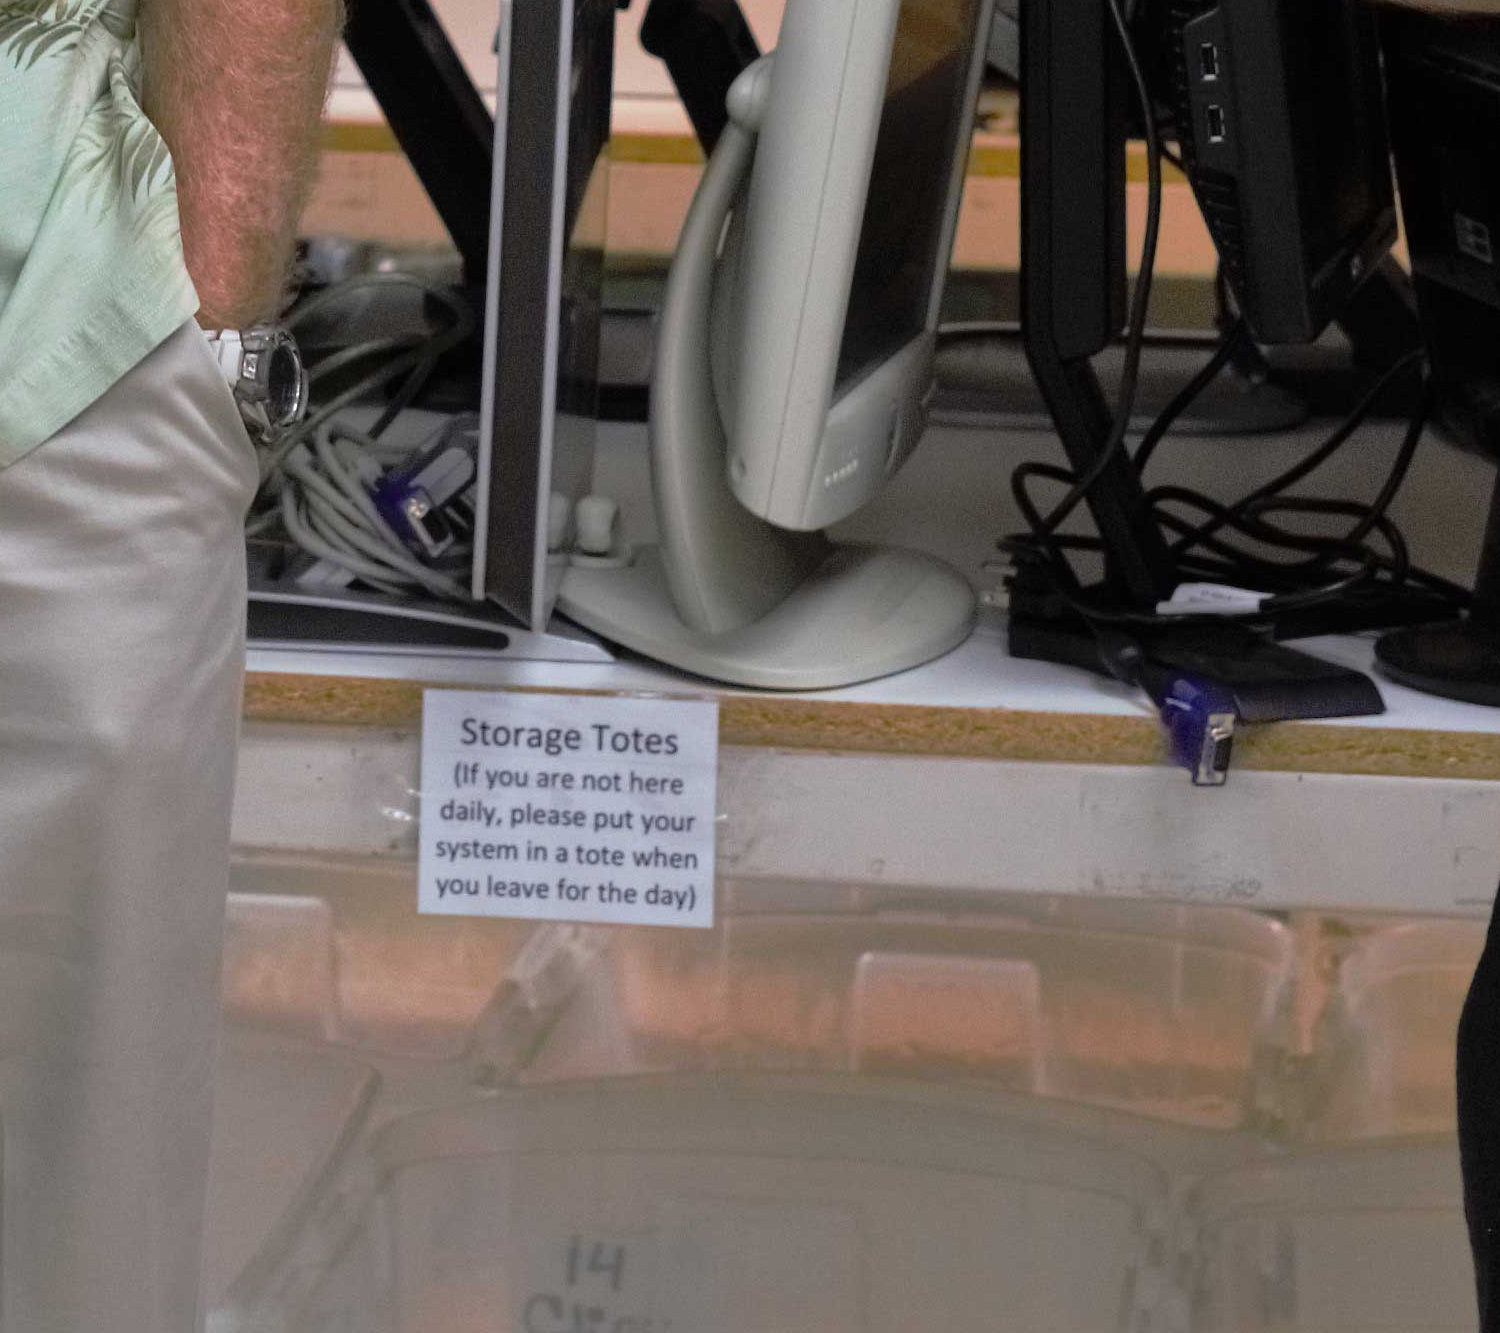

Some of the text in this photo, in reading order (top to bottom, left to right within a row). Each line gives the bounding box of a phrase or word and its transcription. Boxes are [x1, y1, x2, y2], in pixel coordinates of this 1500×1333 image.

[461, 718, 679, 756] Storage Totes
[454, 762, 684, 794] (If you are not here
[440, 800, 695, 834] daily, please put your
[435, 841, 698, 869] system in a tote when
[435, 875, 697, 910] you leave for the day)
